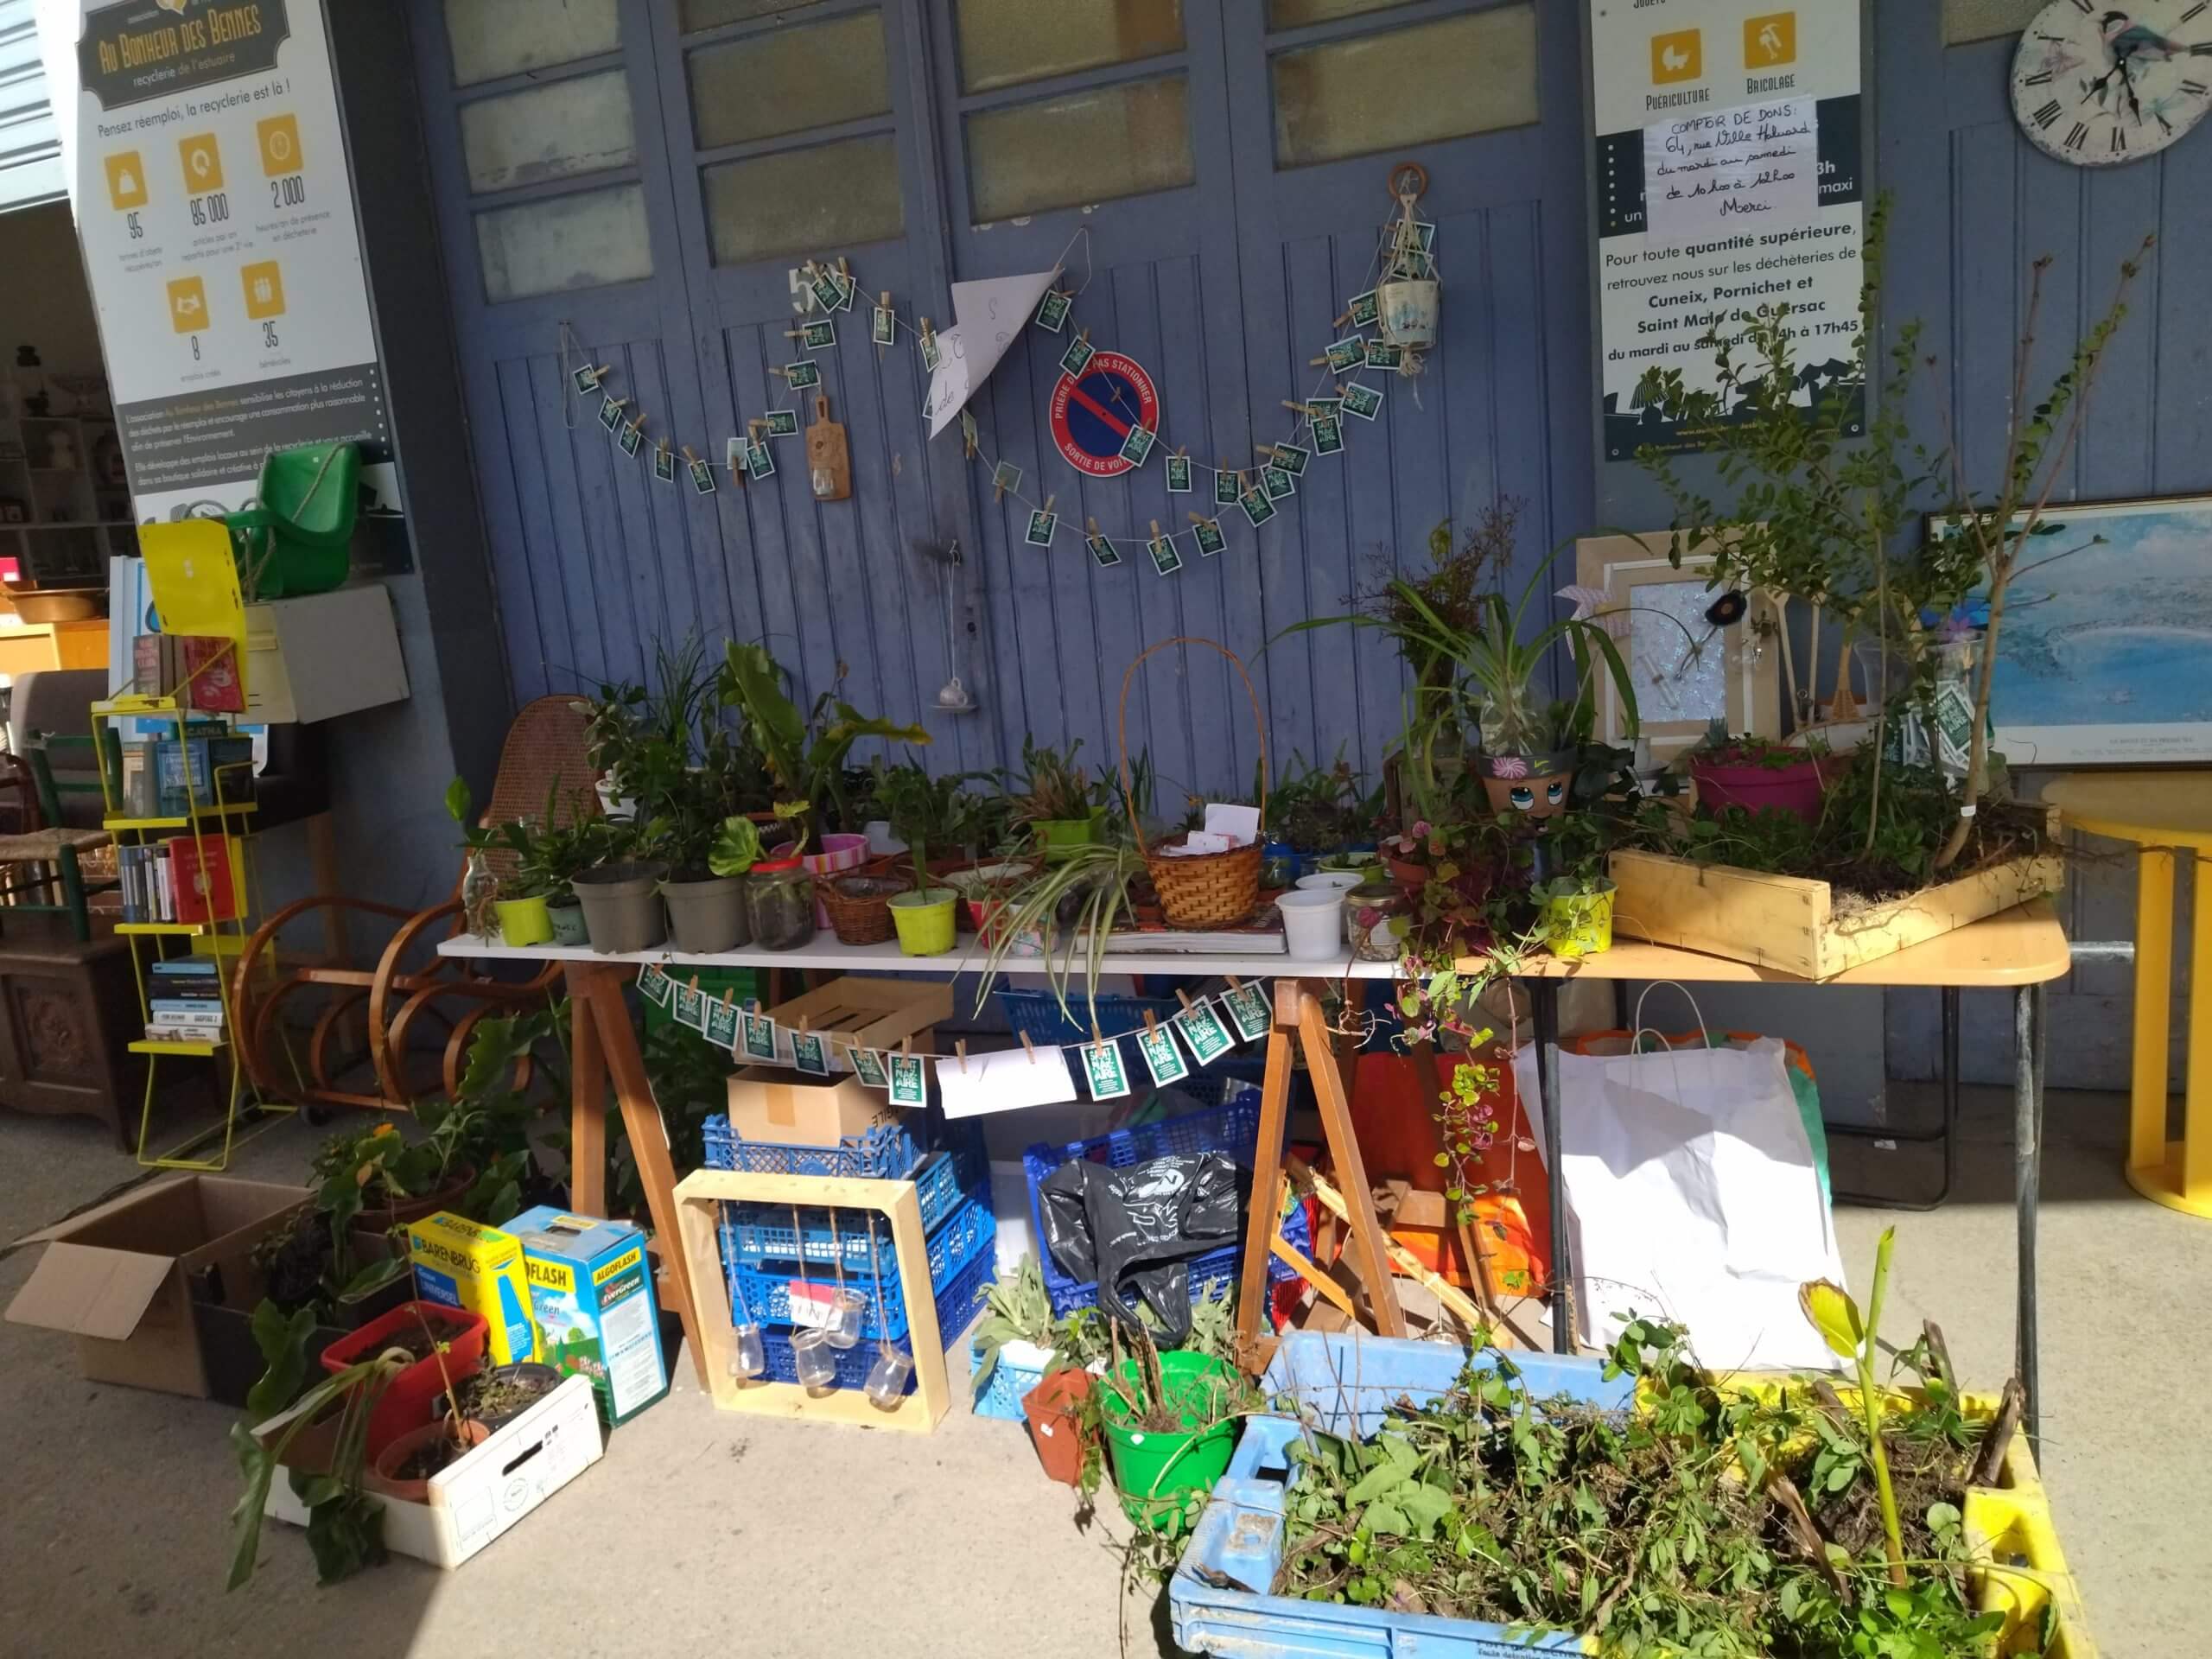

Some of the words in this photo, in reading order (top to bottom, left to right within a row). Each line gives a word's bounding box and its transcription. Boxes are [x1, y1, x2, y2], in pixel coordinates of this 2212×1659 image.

[133, 67, 175, 87] recyclerie
[178, 61, 190, 76] de
[191, 51, 235, 71] l'estuaire
[1747, 74, 1796, 94] BRICOLAGE
[98, 119, 132, 138] Pensez
[135, 106, 184, 130] réemploi,
[186, 102, 197, 117] la
[200, 90, 250, 115] recyclerie
[254, 86, 270, 100] est
[271, 81, 283, 96] là
[1734, 111, 1751, 124] DE
[1694, 141, 1712, 150] rue
[1657, 161, 1675, 175] du
[1677, 158, 1718, 172] mardi
[1720, 157, 1743, 166] au
[1745, 146, 1796, 166] samedi
[271, 180, 282, 209] 2
[284, 175, 305, 206] 000
[1666, 185, 1683, 200] de
[1732, 179, 1745, 188] à
[1818, 177, 1853, 194] maxi
[190, 199, 207, 226] 85
[209, 194, 230, 222] 000
[1720, 198, 1772, 216] Merci
[127, 212, 143, 238] 95
[1606, 253, 1638, 267] Pour
[1643, 248, 1680, 263] toute
[1685, 235, 1754, 257] quantité
[1759, 223, 1856, 246] supérieure,
[1607, 273, 1668, 290] retrouvez
[1672, 268, 1704, 282] nous
[1707, 266, 1729, 278] sur
[1733, 259, 1751, 273] les
[1756, 251, 1834, 271] déchèteries
[1839, 246, 1856, 259] de
[1649, 289, 1707, 309] Cuneix,
[1713, 276, 1791, 301] Pornichet
[1797, 276, 1813, 290] et
[263, 321, 278, 347] 35
[1638, 316, 1678, 334] Saint
[1683, 309, 1726, 328] Mal
[1730, 308, 1750, 323] d
[192, 335, 200, 360] 8
[1609, 347, 1625, 361] du
[1629, 342, 1669, 359] mardi
[1673, 340, 1690, 353] au
[1748, 330, 1765, 344] d
[1772, 327, 1796, 341] 4h
[1801, 324, 1809, 338] à
[1815, 320, 1858, 336] 17h45
[238, 391, 272, 404] sensibilise
[274, 389, 283, 399] les
[285, 385, 312, 399] citoyens
[329, 376, 362, 390] réduction
[1055, 385, 1070, 418] PRIERE
[1112, 359, 1153, 404] STATIONNER
[214, 413, 247, 425] encourage
[261, 401, 308, 416] consommation
[310, 399, 324, 410] plus
[325, 392, 365, 407] raisonnable
[217, 448, 238, 459] locaux
[249, 445, 262, 455] sein
[1065, 442, 1092, 468] SORTIE
[1094, 461, 1105, 470] DE
[422, 1239, 480, 1274] BARENBRUG
[596, 1251, 636, 1282] ALGOFLASH
